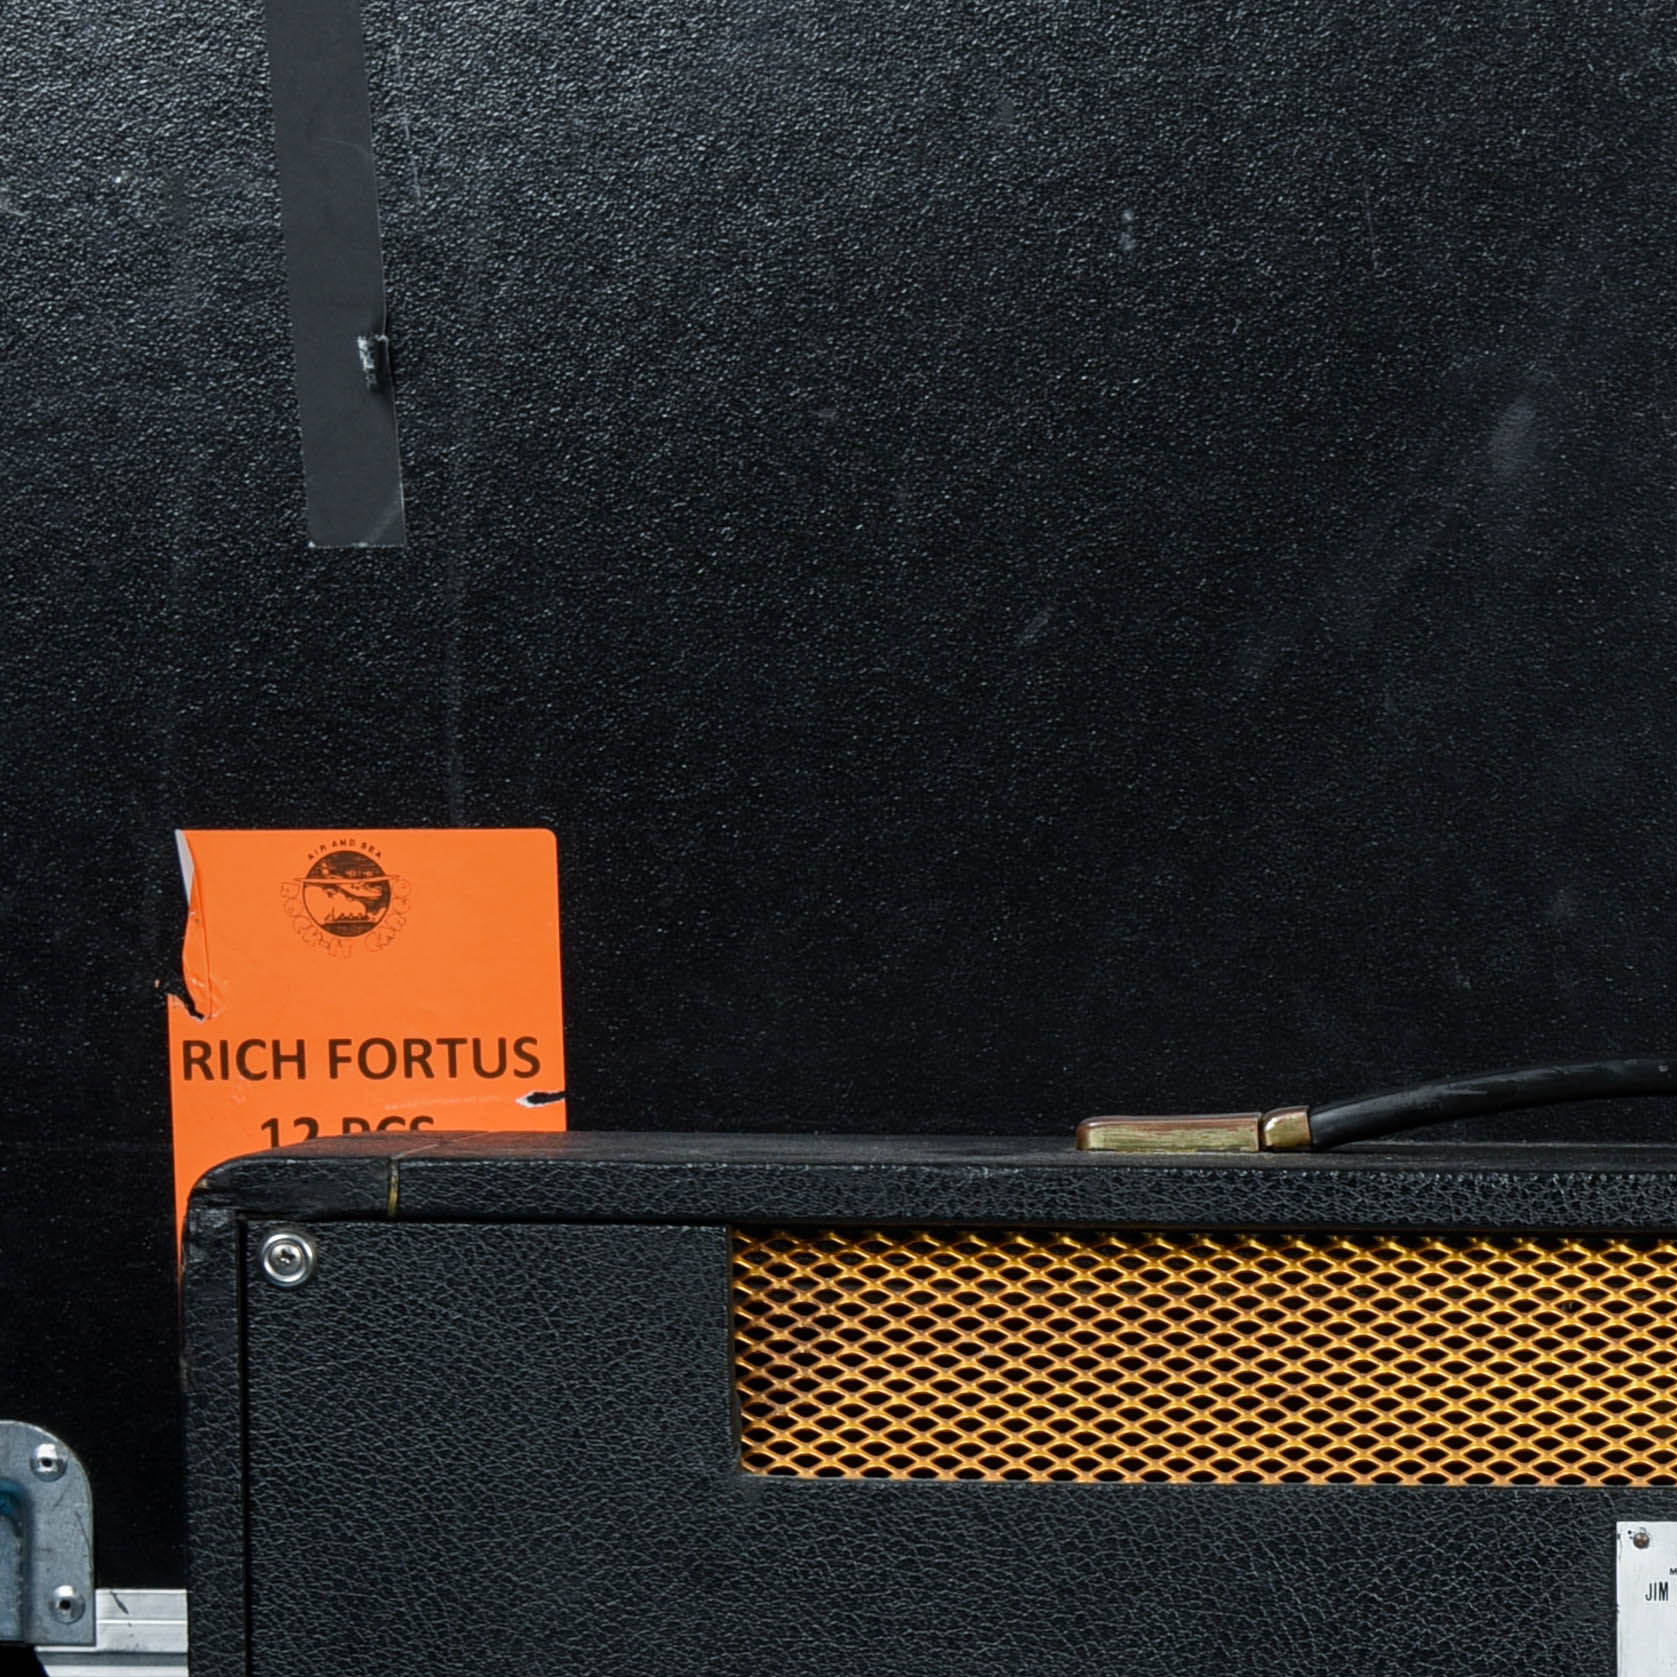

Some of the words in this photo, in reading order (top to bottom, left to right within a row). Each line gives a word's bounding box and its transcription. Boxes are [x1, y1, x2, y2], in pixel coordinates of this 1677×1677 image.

[182, 1037, 307, 1081] RICH
[328, 1036, 541, 1080] FORTUS
[1645, 1581, 1669, 1602] JIM
